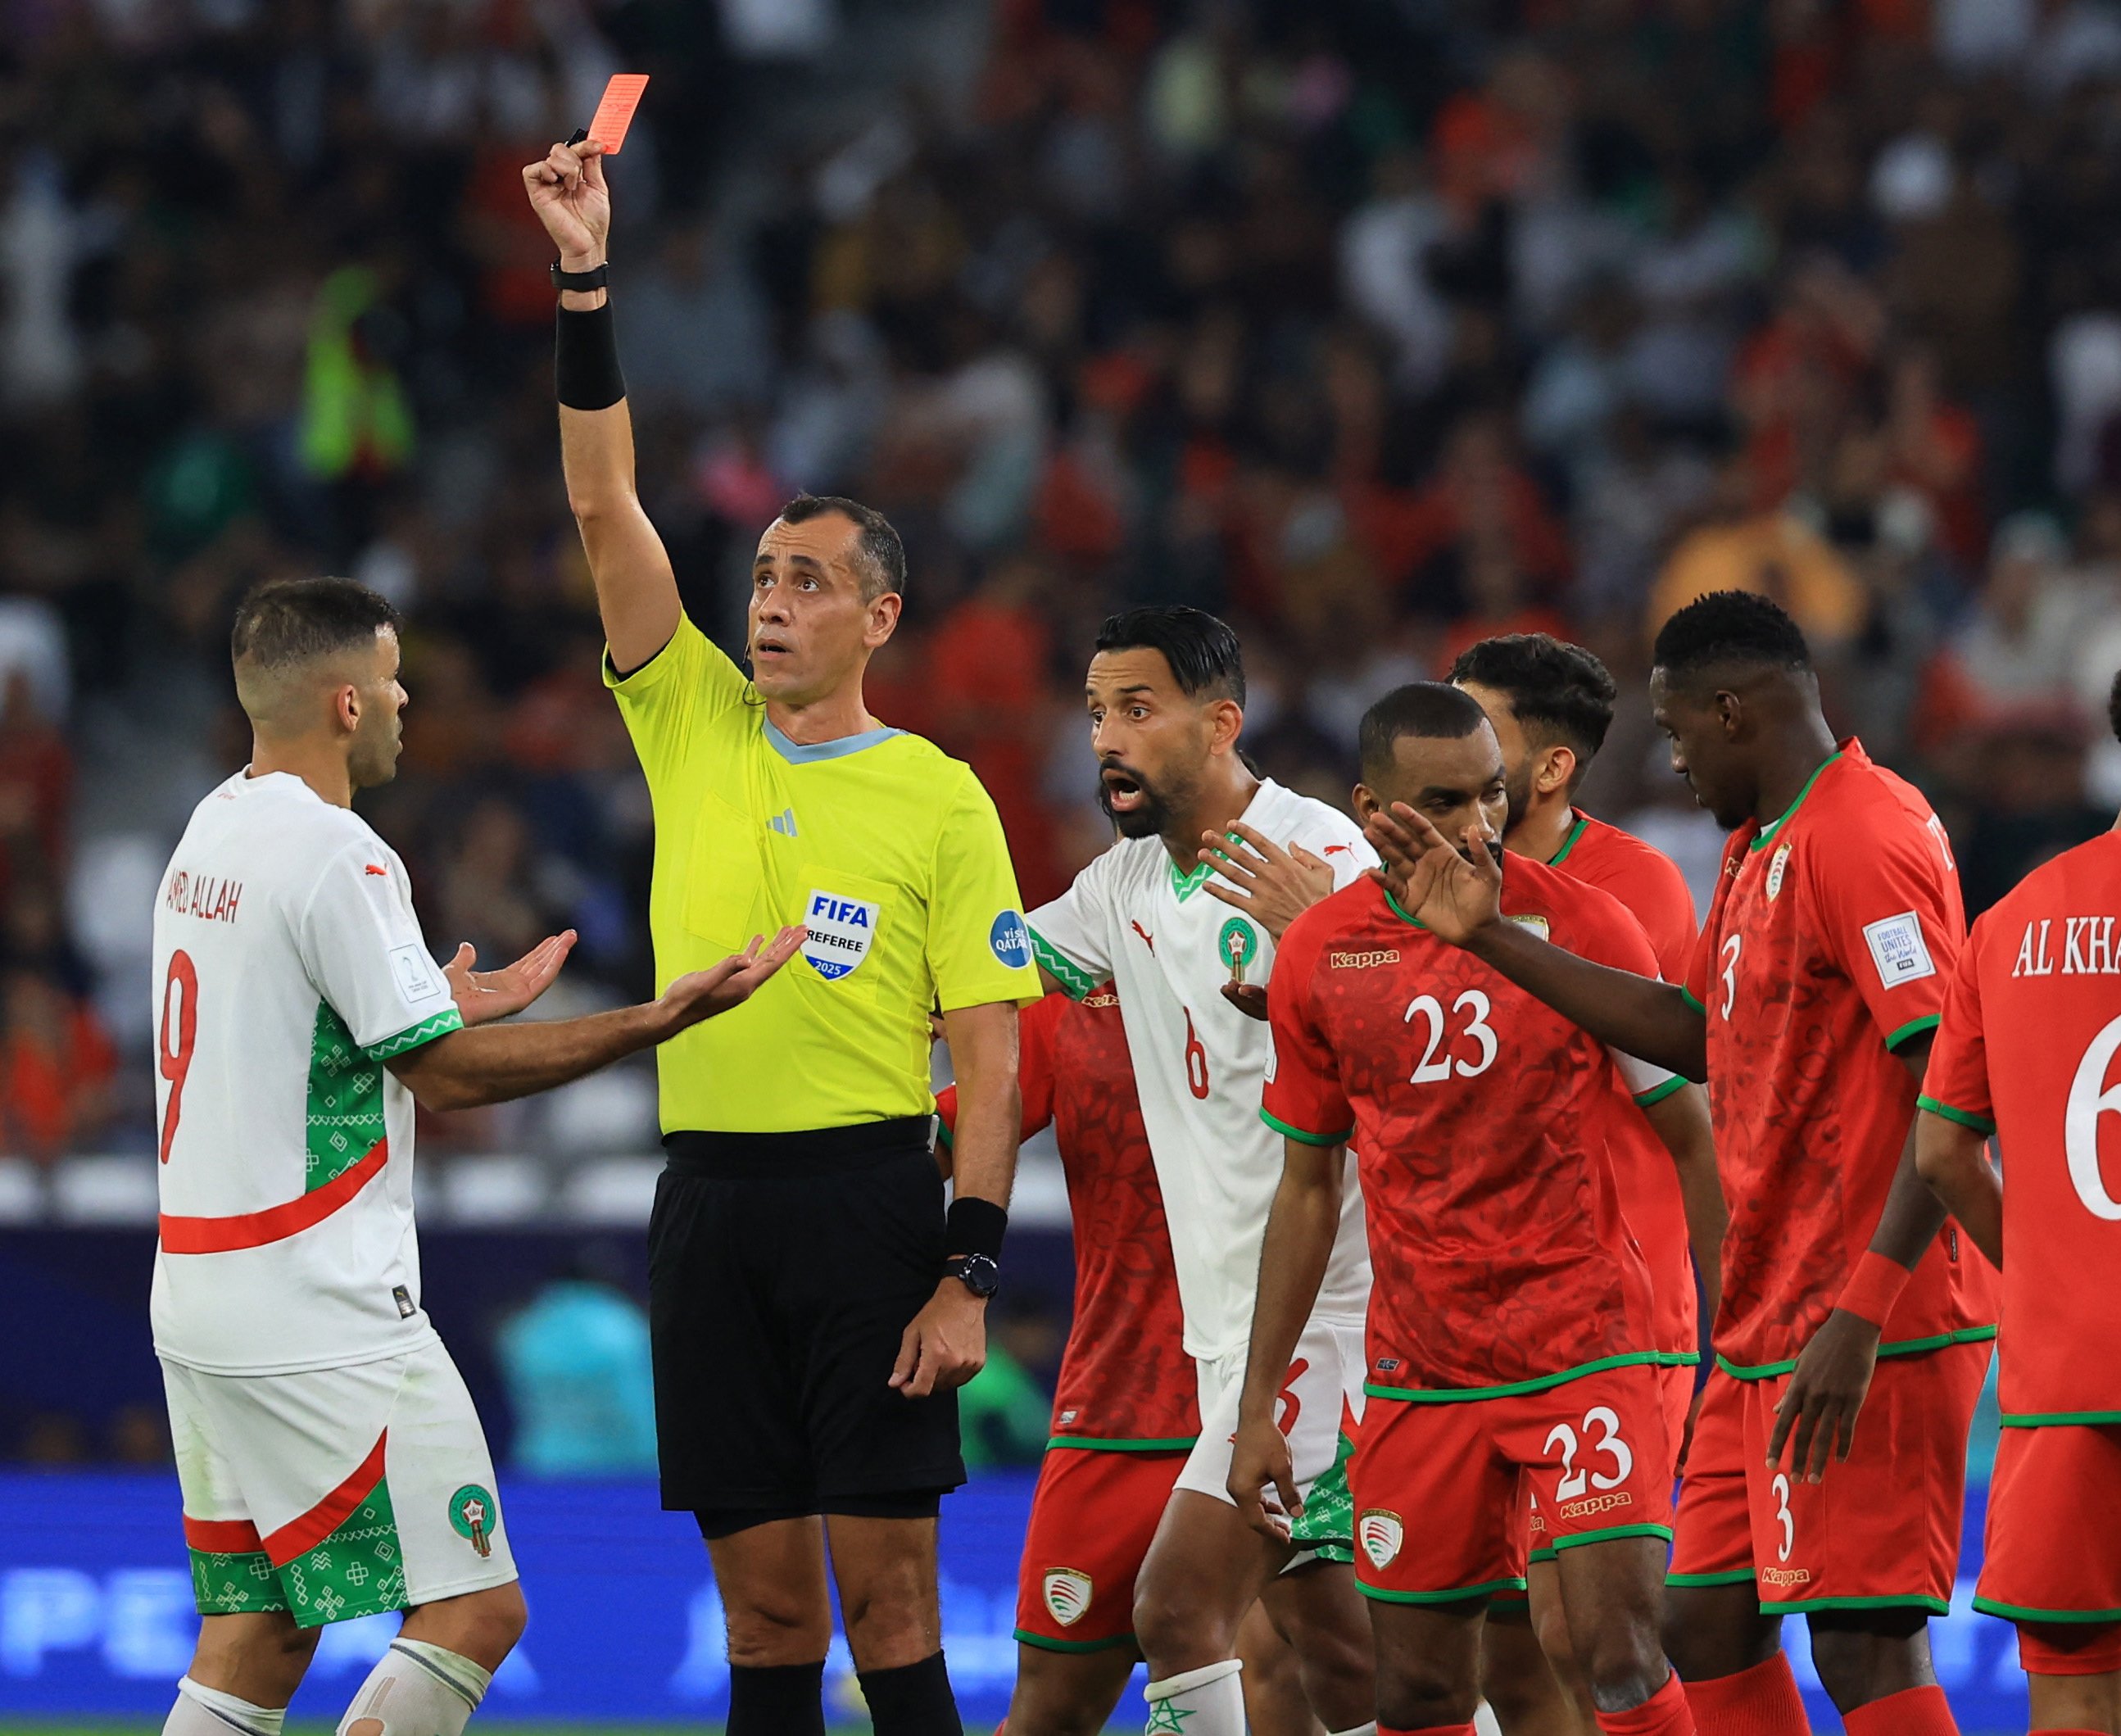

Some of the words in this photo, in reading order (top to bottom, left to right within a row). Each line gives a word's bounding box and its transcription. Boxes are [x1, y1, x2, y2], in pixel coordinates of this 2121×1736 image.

[191, 874, 242, 924] ALLAH
[812, 895, 868, 928] FIFA
[807, 929, 863, 952] REFEREE
[1330, 950, 1400, 968] Kappa
[1881, 934, 1912, 952] UNITES
[2011, 918, 2054, 978] AL
[814, 960, 842, 976] 2025
[1721, 933, 1741, 1022] 3
[160, 949, 198, 1165] 9
[1182, 1005, 1210, 1100] 6
[1403, 989, 1498, 1085] 23
[1543, 1406, 1633, 1503] 23
[1560, 1492, 1632, 1519] Kappa
[1772, 1473, 1793, 1562] 3
[1761, 1566, 1811, 1587] Kappa
